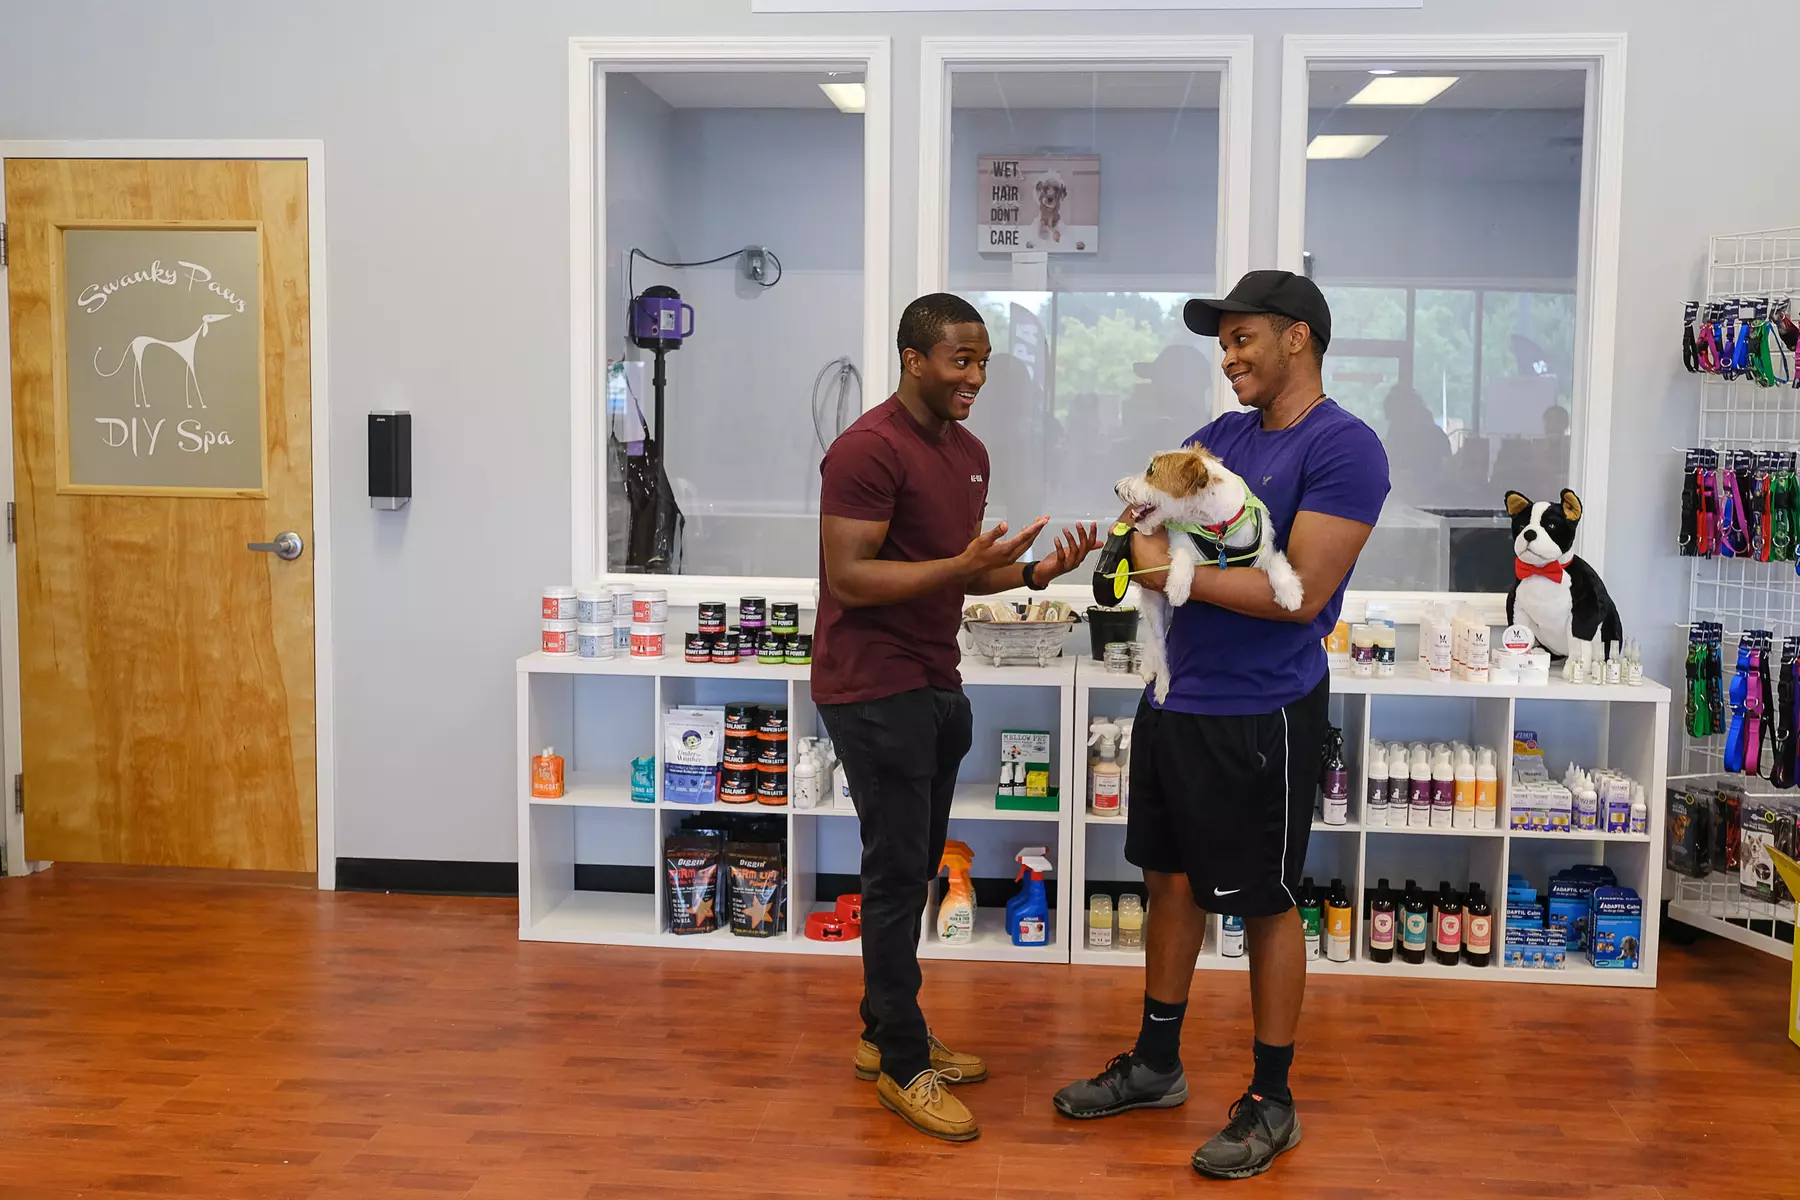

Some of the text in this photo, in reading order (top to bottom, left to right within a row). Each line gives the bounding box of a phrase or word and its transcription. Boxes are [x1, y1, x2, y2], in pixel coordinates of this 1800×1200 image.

[993, 161, 1019, 177] WET
[992, 186, 1019, 201] HAIR
[991, 208, 1019, 221] DON'T
[990, 230, 1019, 245] CARE
[77, 260, 246, 313] Swanky Paws
[95, 417, 235, 457] DIY Spa
